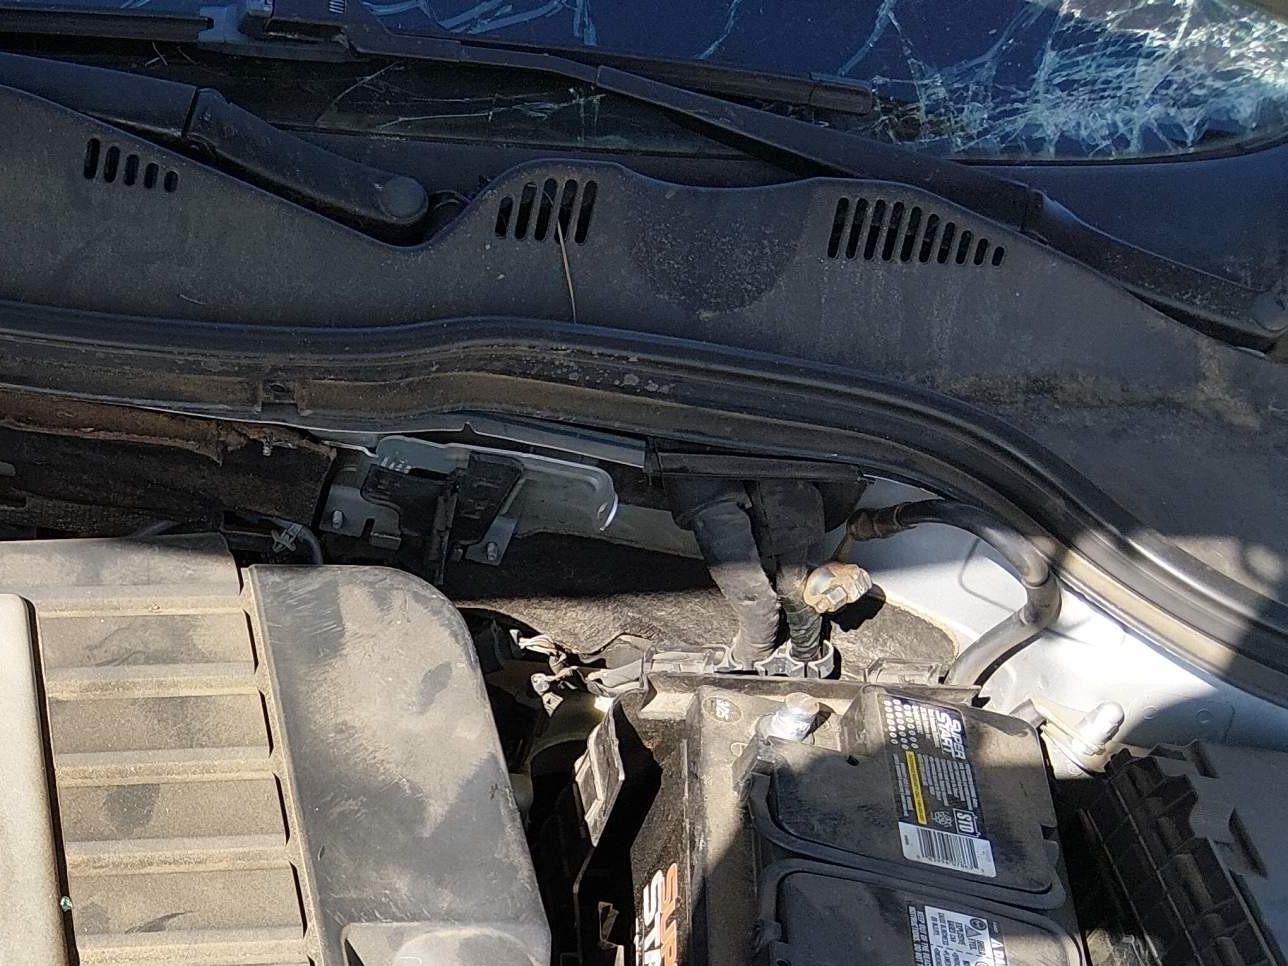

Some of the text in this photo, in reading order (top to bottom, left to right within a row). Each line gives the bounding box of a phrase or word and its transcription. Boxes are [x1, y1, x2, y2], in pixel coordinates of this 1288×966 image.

[935, 709, 954, 755] START
[951, 719, 967, 761] SUPER
[956, 811, 975, 834] STD
